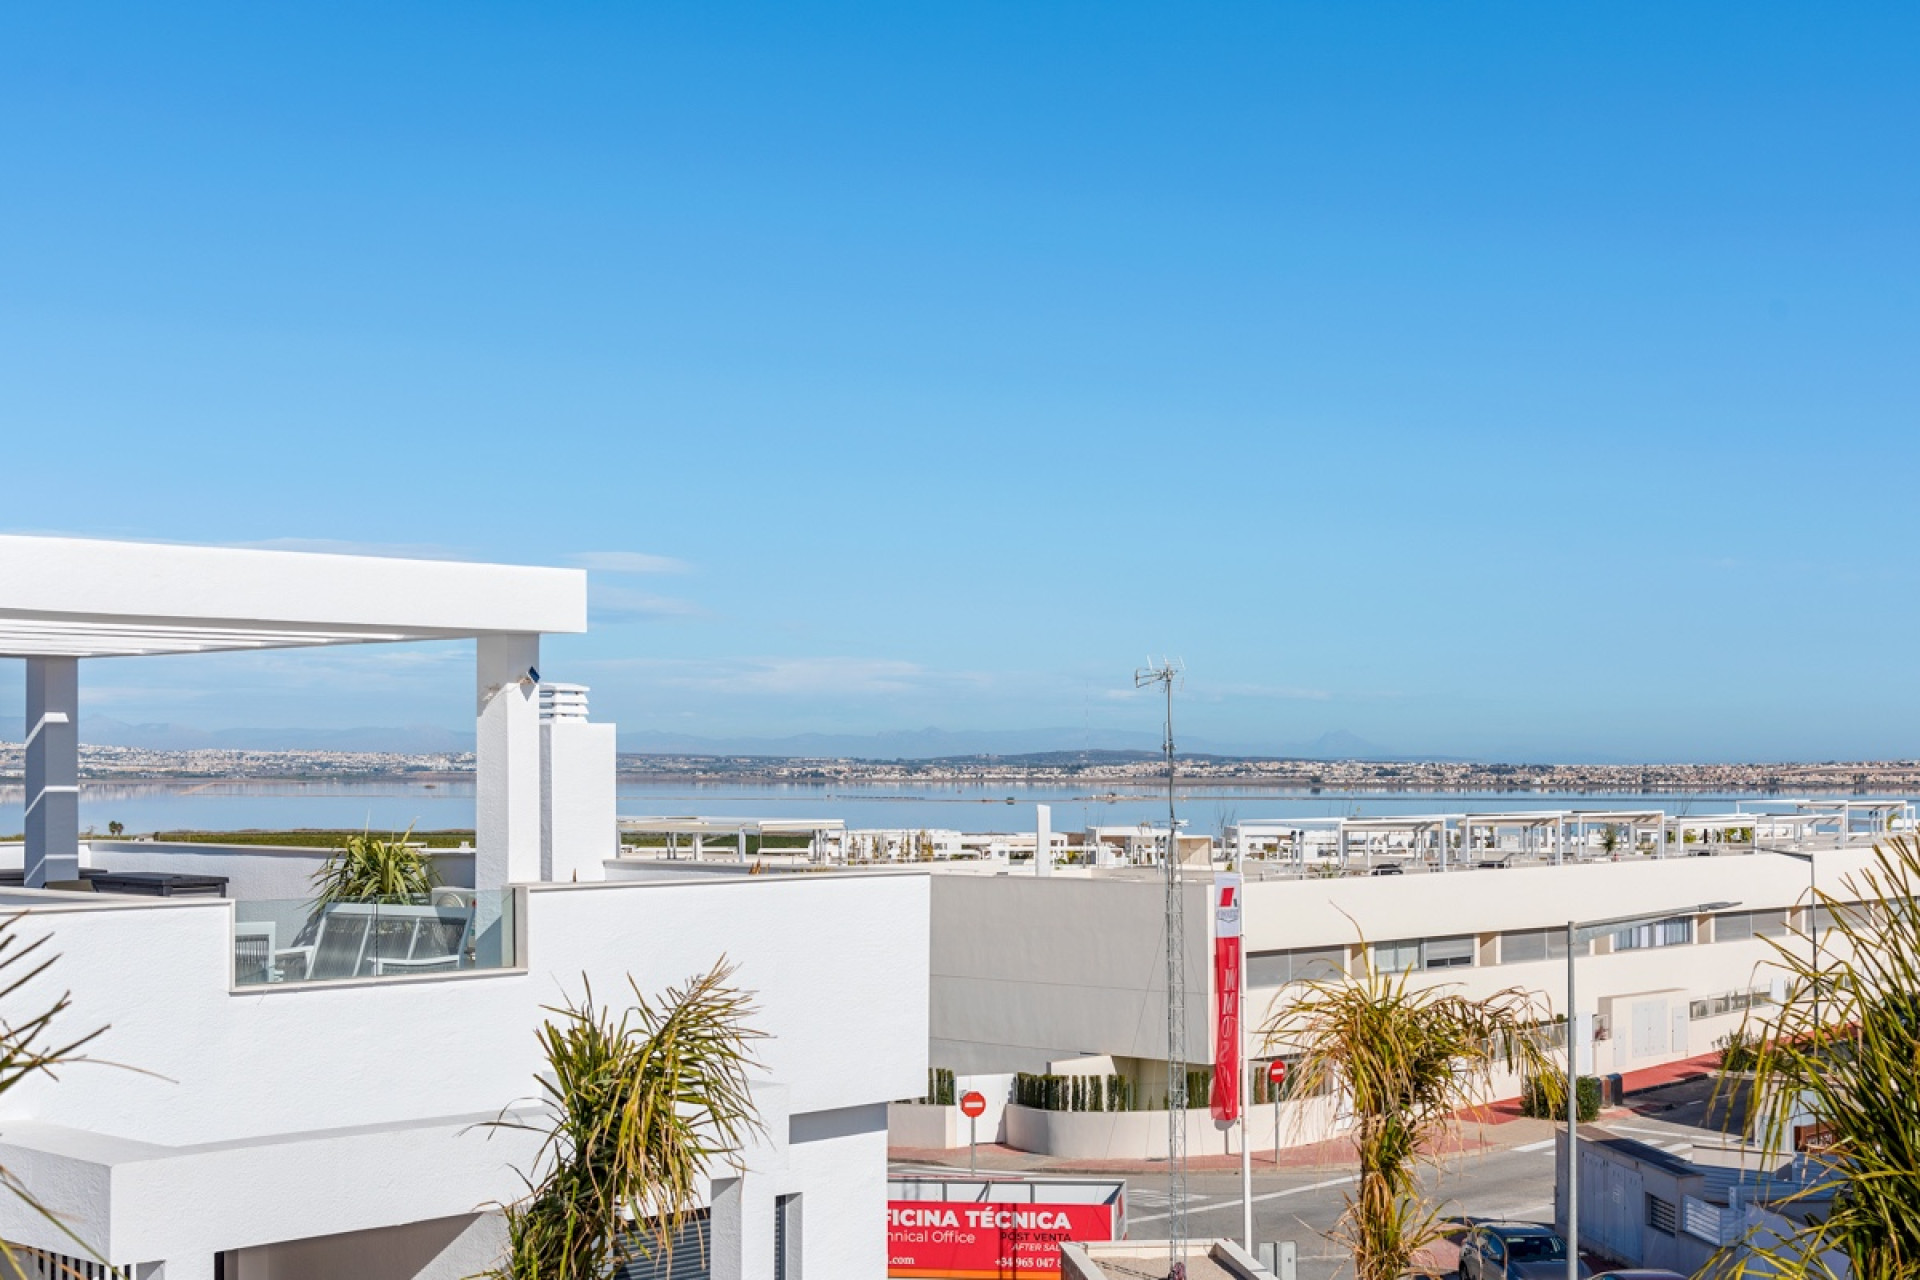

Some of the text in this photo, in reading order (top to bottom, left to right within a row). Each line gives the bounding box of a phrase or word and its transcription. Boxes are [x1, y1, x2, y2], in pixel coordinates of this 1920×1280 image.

[965, 1206, 1072, 1230] TÉCNICA
[932, 1230, 975, 1243] Office
[1001, 1232, 1071, 1241] POST VENTA
[1011, 1243, 1041, 1252] AFTER
